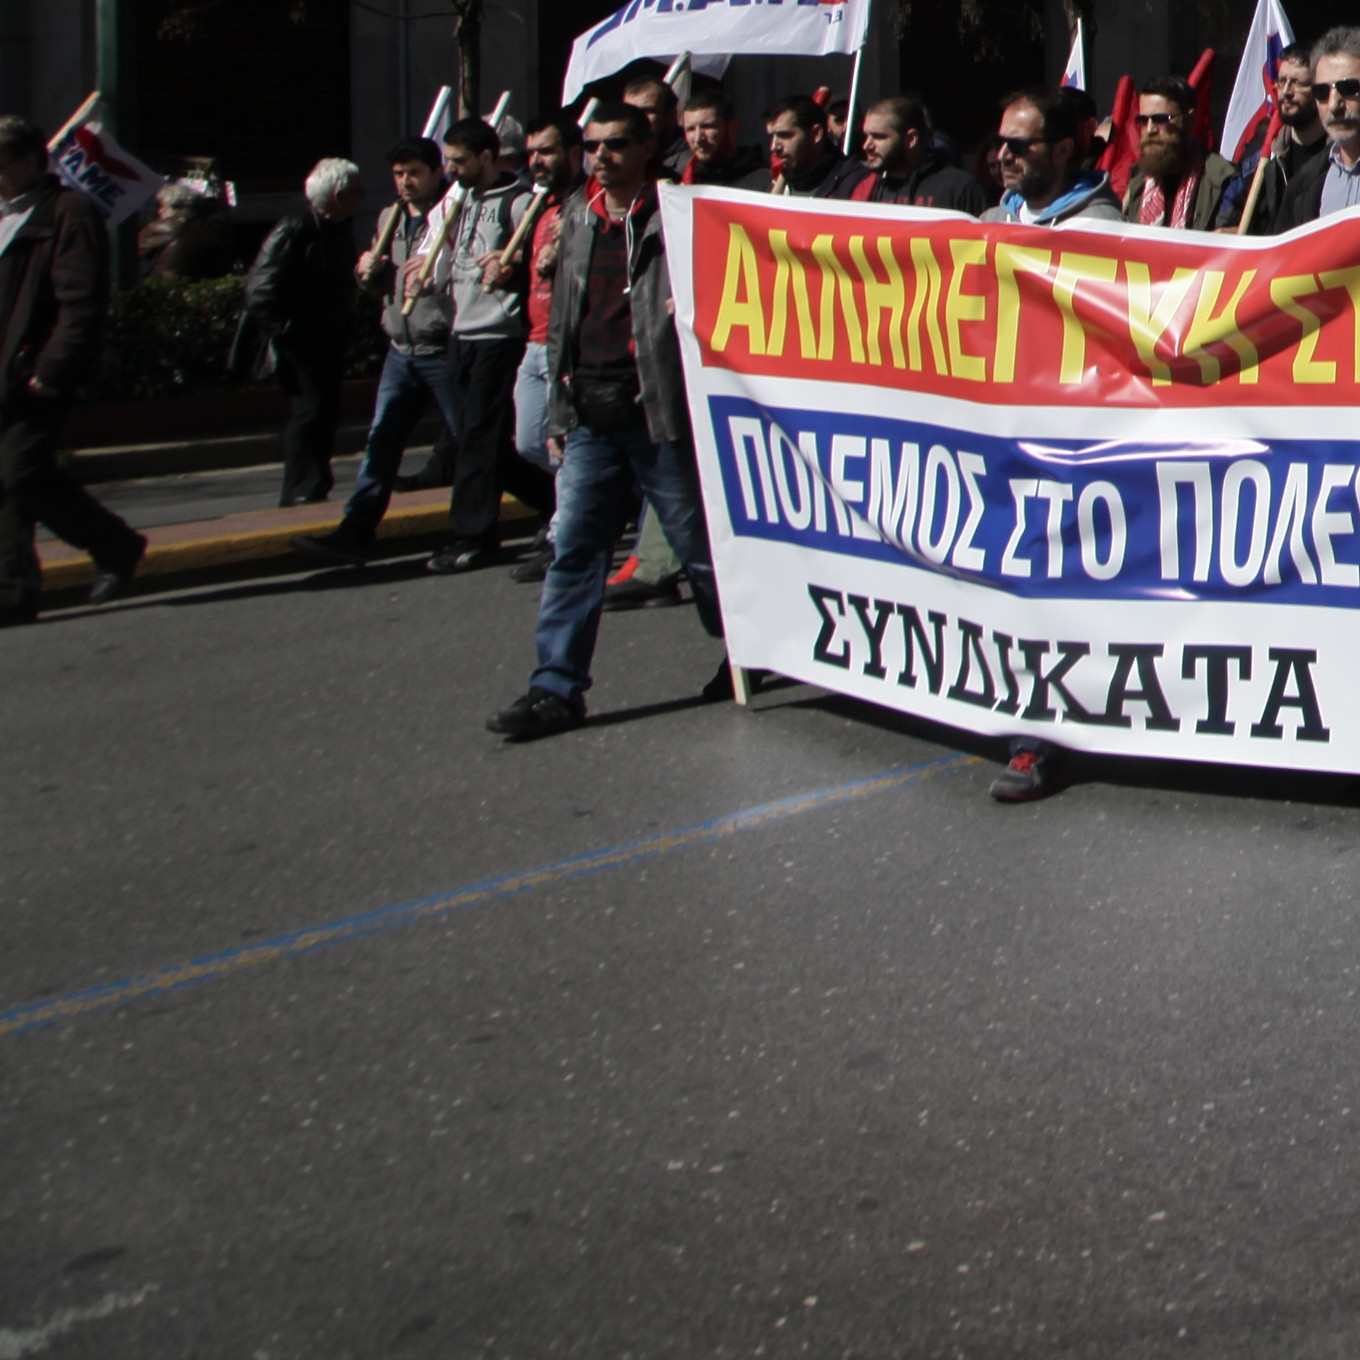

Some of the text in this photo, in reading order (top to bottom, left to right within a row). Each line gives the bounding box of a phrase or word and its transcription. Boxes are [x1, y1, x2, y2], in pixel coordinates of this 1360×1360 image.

[726, 415, 988, 572] ΠΟΛΕΜΟΣ
[1001, 478, 1127, 581] ΣΤΟ
[807, 584, 1331, 744] ΣΥΝΔΙΚΑΤΑ
